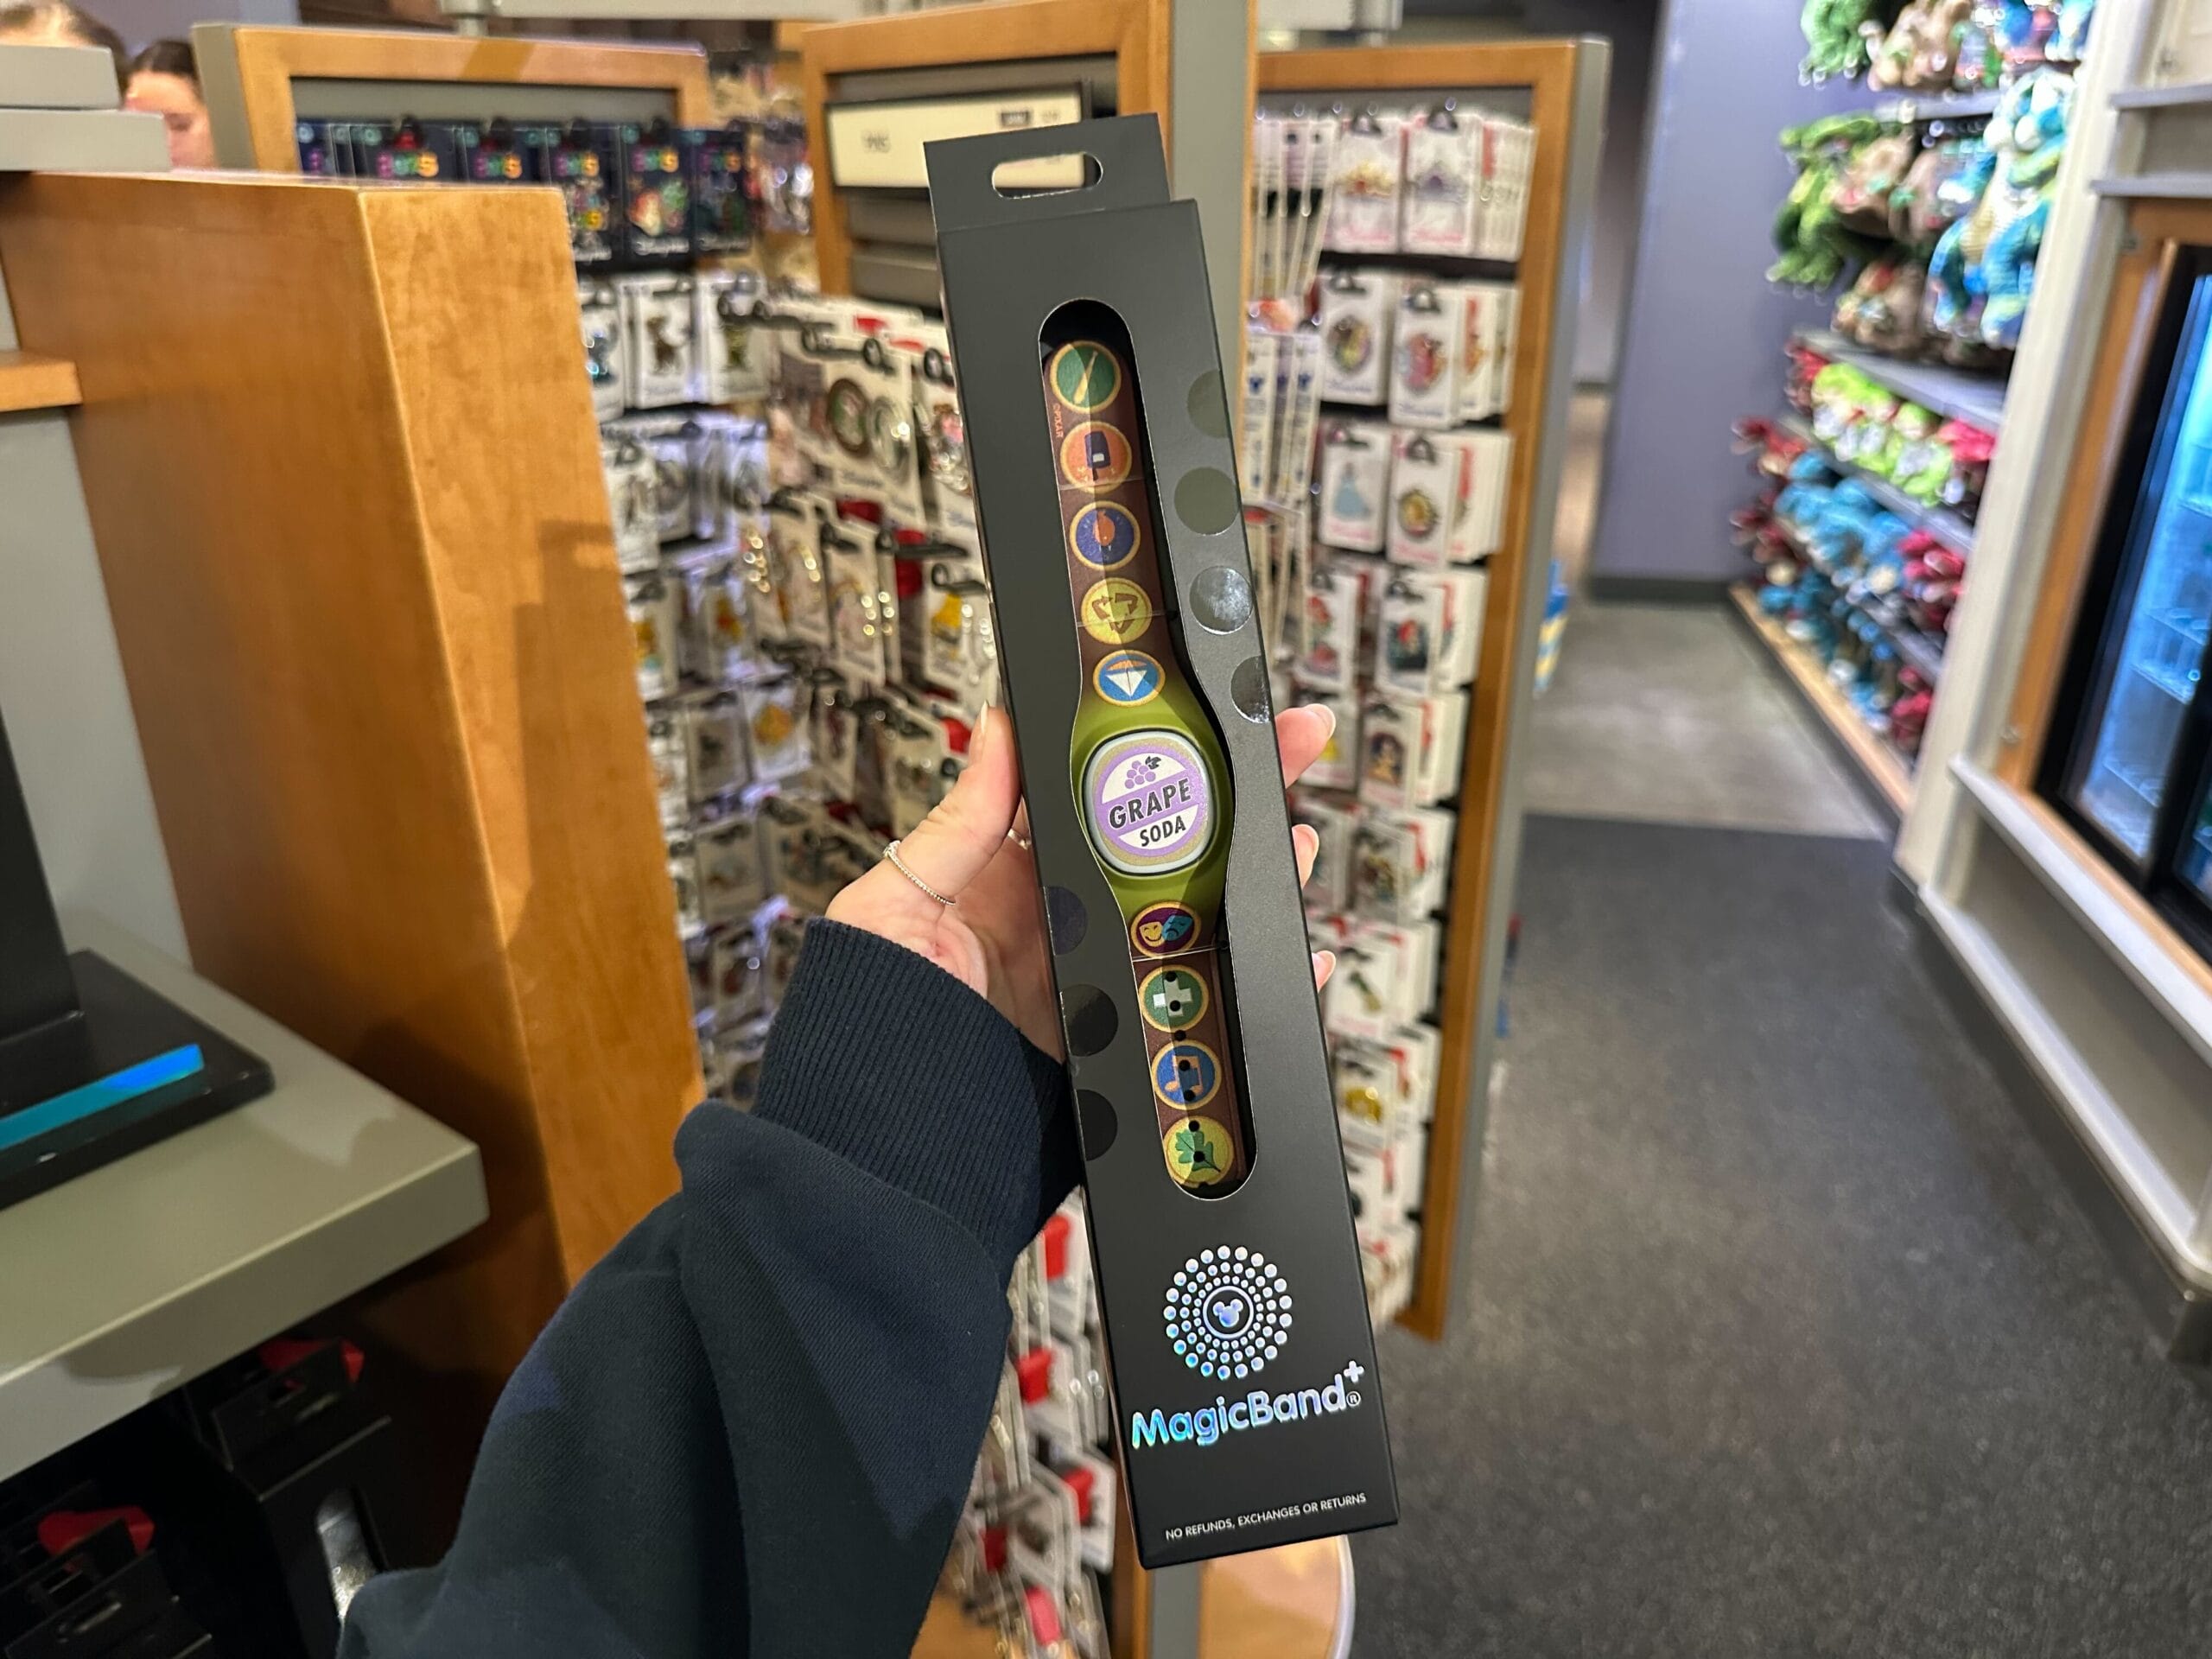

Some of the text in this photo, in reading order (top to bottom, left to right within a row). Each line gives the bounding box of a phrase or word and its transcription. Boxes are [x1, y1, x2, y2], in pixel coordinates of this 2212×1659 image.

[1109, 777, 1192, 830] GRAPE
[1139, 815, 1186, 847] SODA
[1166, 1491, 1367, 1541] NO REFUNDS, EXCHANGES OR RETURNS
